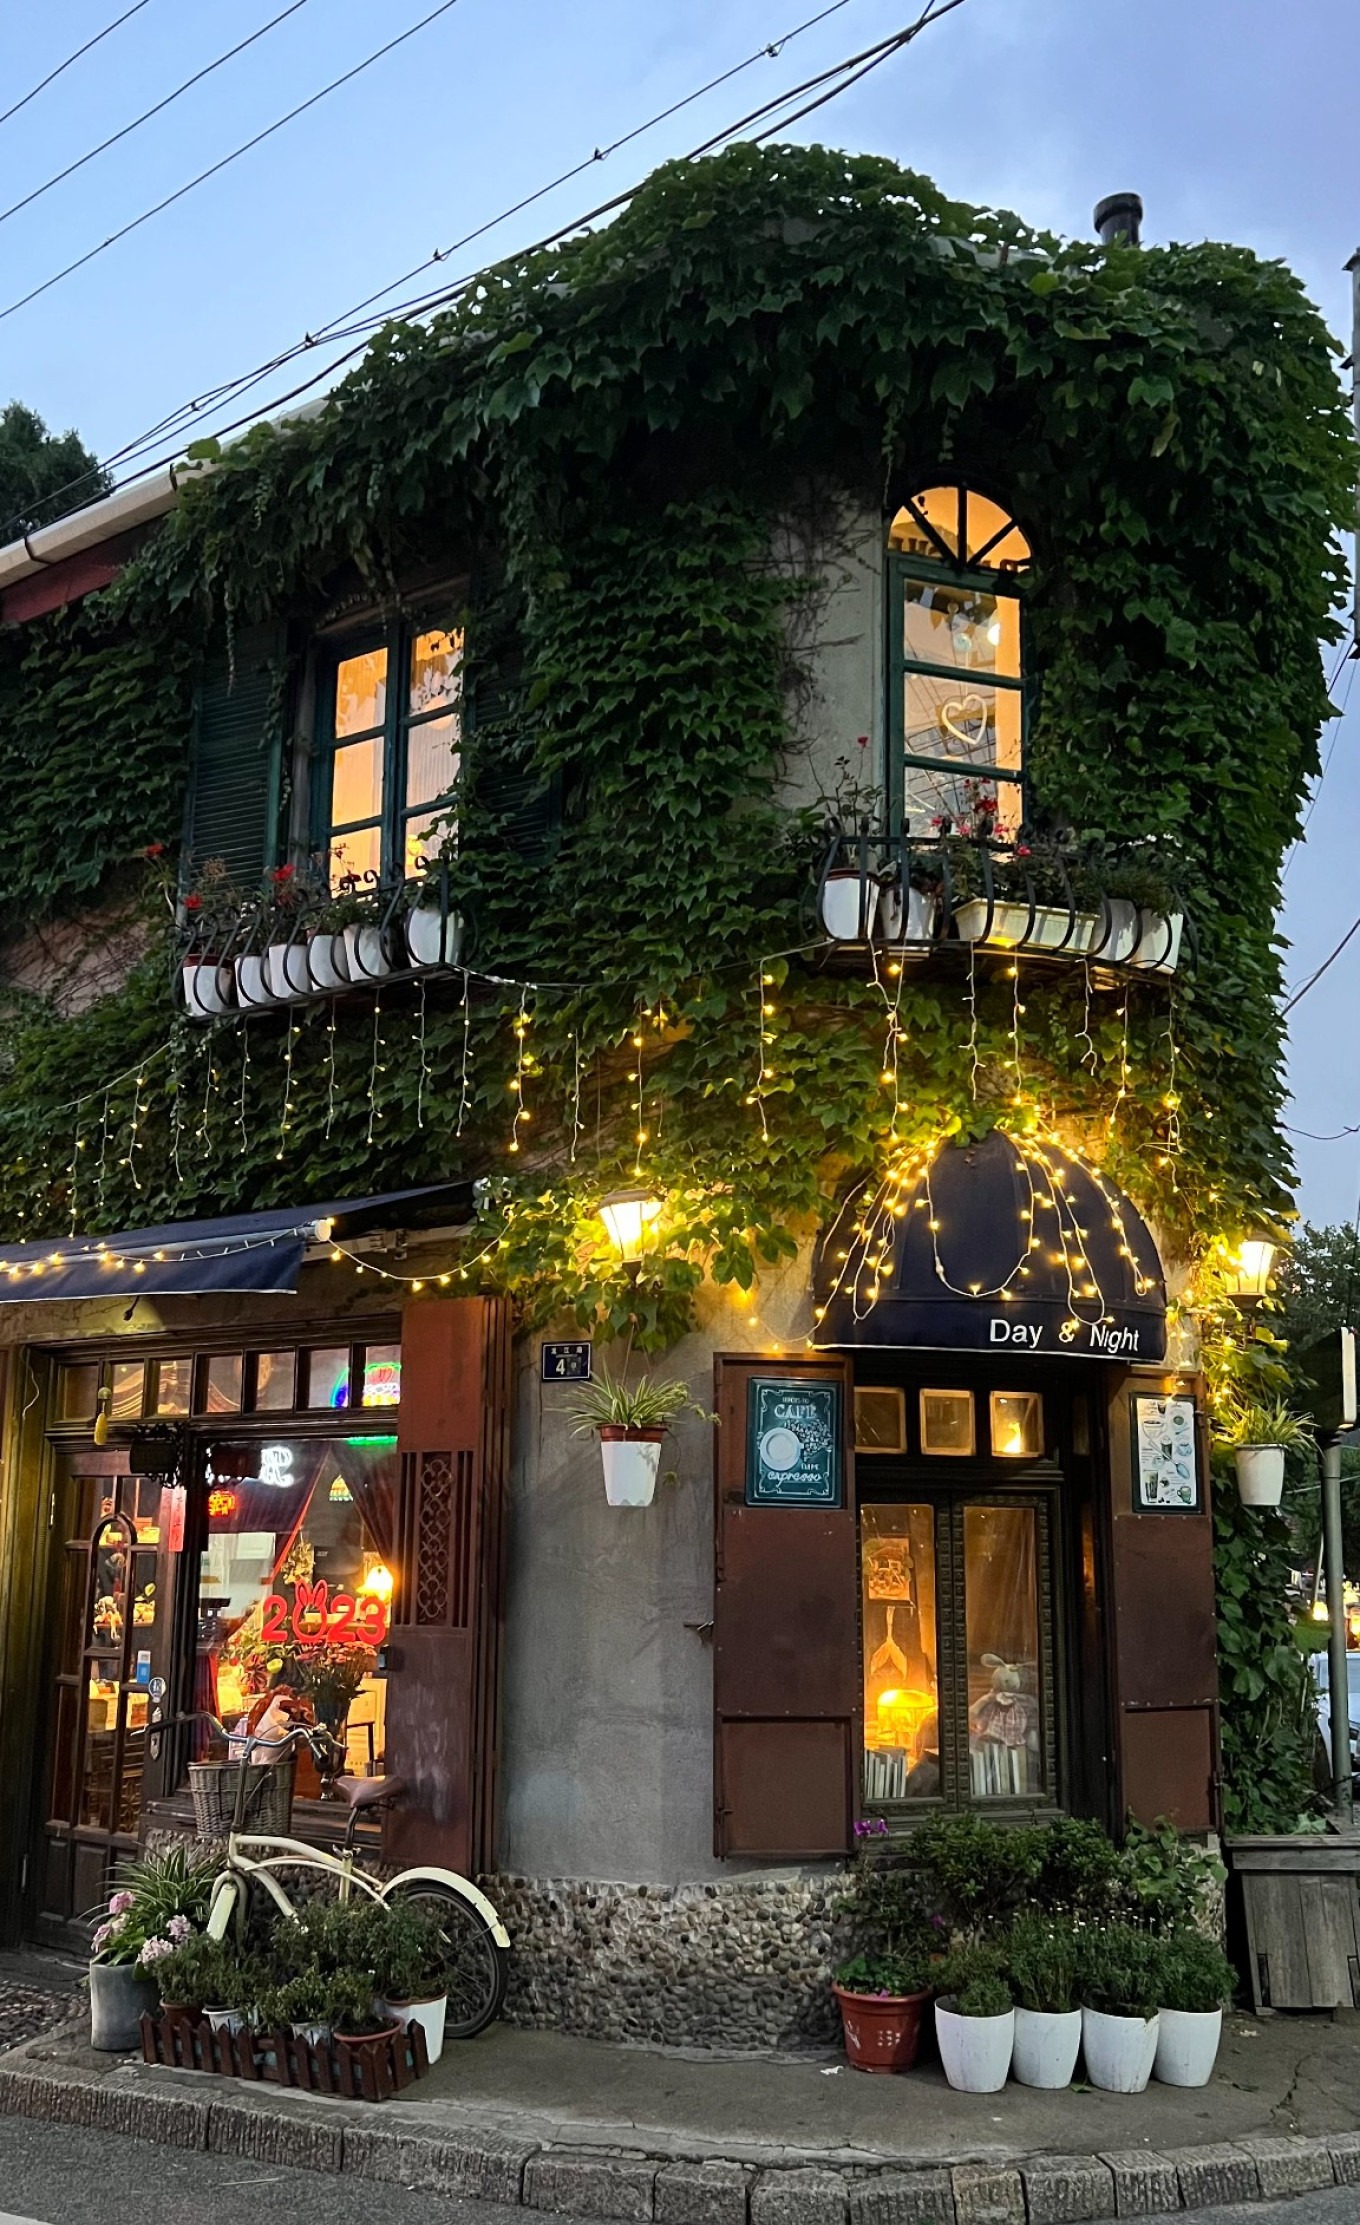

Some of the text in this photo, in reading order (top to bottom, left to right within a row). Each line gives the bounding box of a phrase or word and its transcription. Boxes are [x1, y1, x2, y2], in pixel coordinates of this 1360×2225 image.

[989, 1319, 1140, 1353] Day & Night
[261, 1580, 386, 1645] 2023
